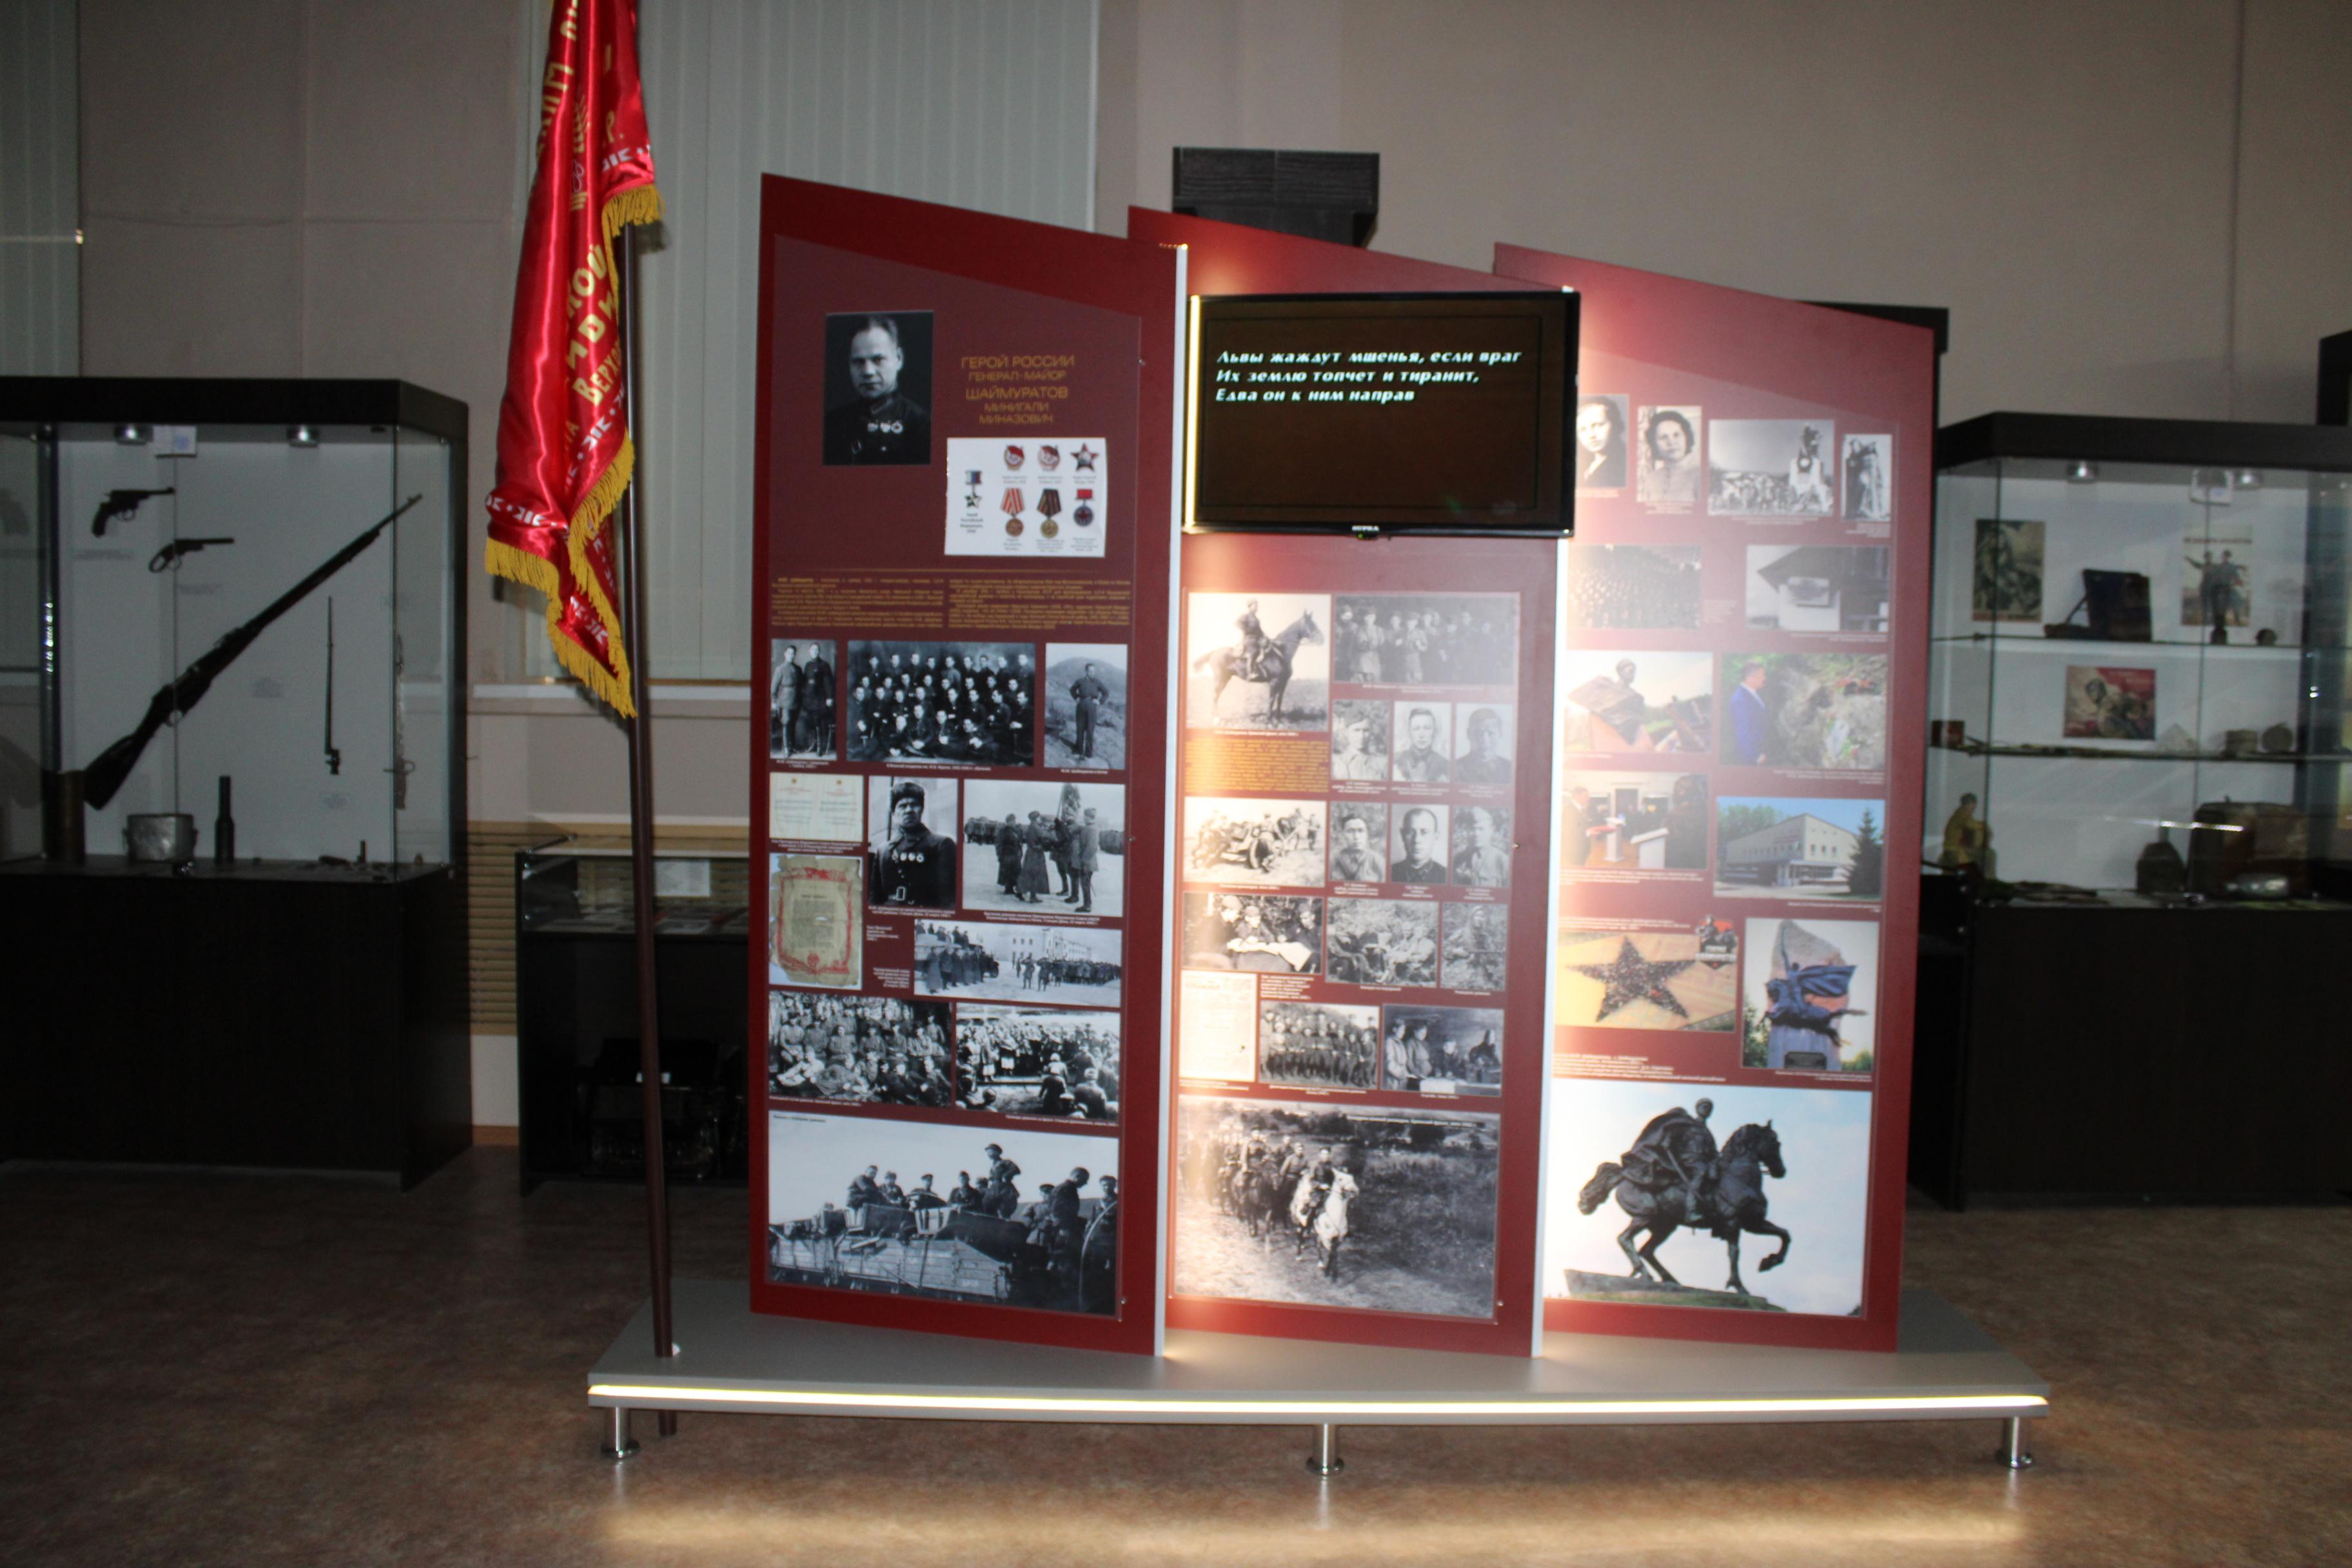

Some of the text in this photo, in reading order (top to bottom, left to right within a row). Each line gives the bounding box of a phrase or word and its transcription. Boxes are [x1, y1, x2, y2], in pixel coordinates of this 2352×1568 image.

[961, 355, 1075, 369] ГЕРОЙ РОССИИ
[1217, 350, 1264, 364] Львы
[1269, 352, 1342, 366] жаждут
[1429, 352, 1474, 363] если
[1478, 352, 1522, 366] враг
[1216, 369, 1480, 386] Их землю топчет и тиранит,
[966, 386, 1069, 400] ШАЙМУРАТОВ
[1215, 388, 1415, 405] Едва он к ним направ
